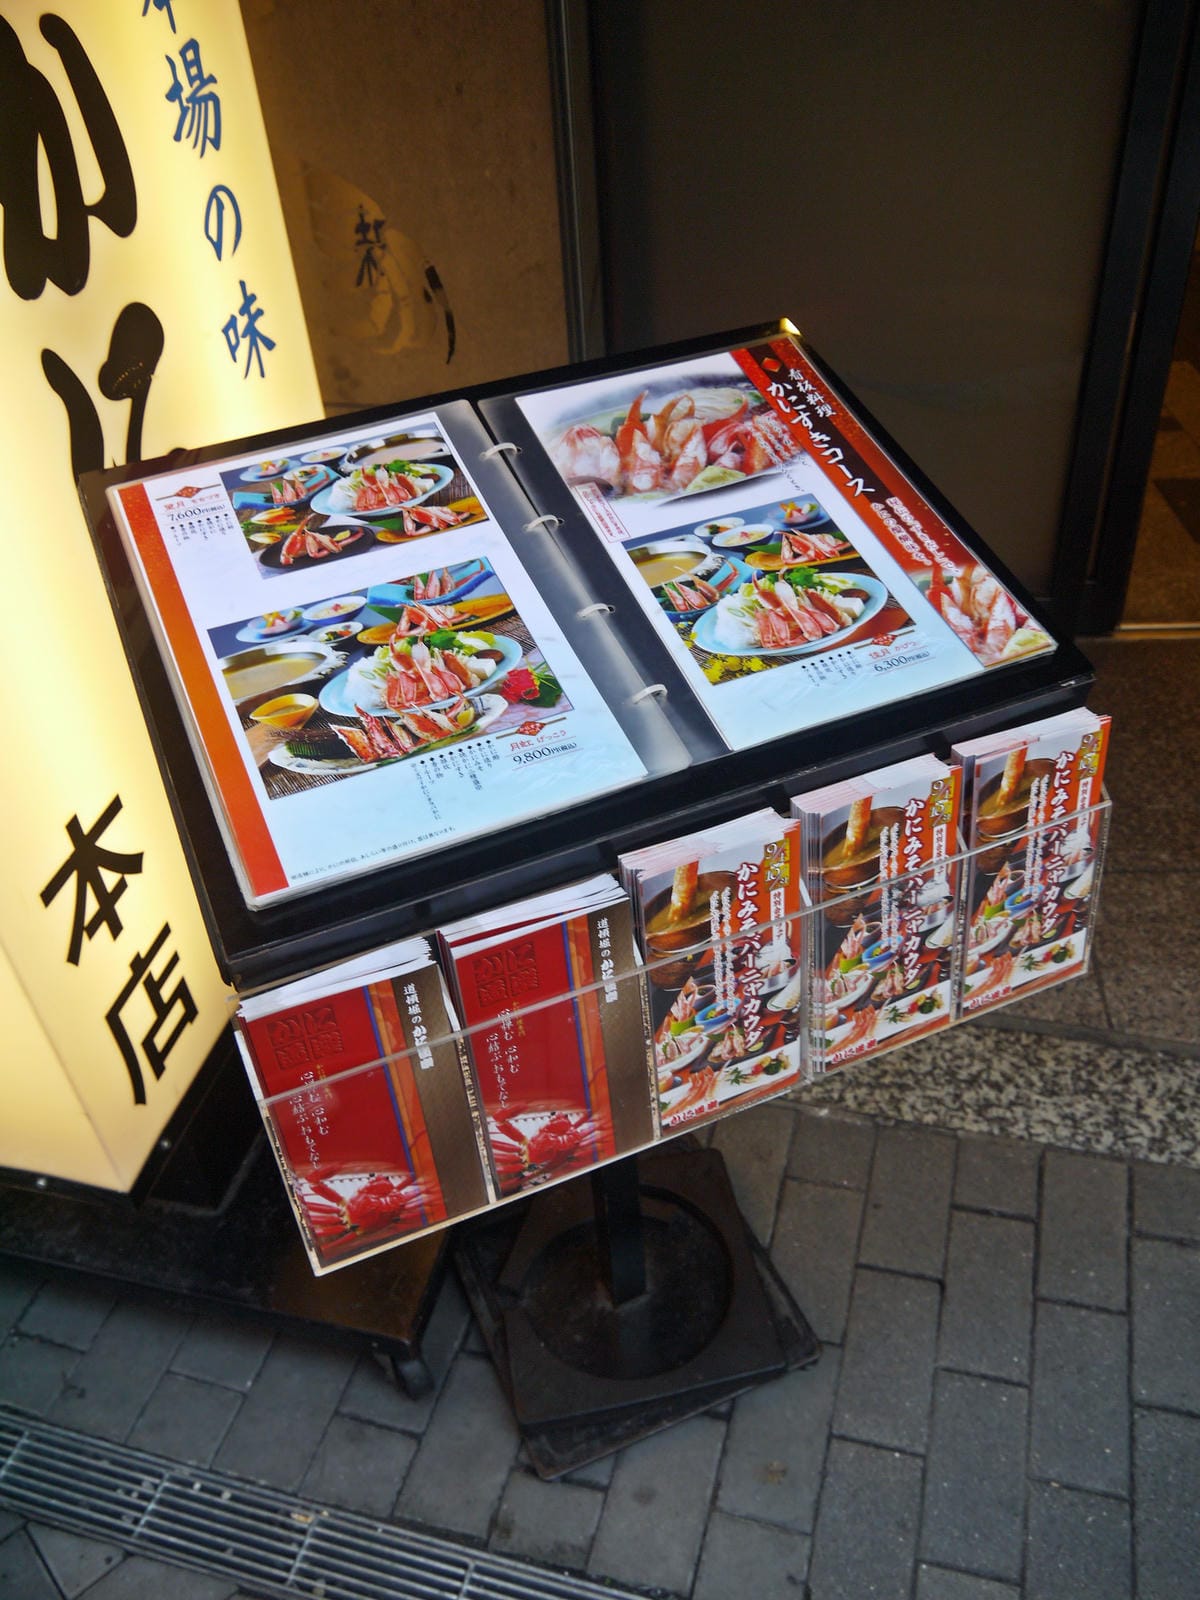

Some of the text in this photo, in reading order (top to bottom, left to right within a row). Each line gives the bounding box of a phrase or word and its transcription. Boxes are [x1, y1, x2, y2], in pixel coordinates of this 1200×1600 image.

[766, 381, 876, 497] かにすきコース
[788, 368, 837, 418] 看板料理
[40, 794, 199, 1105] 本店
